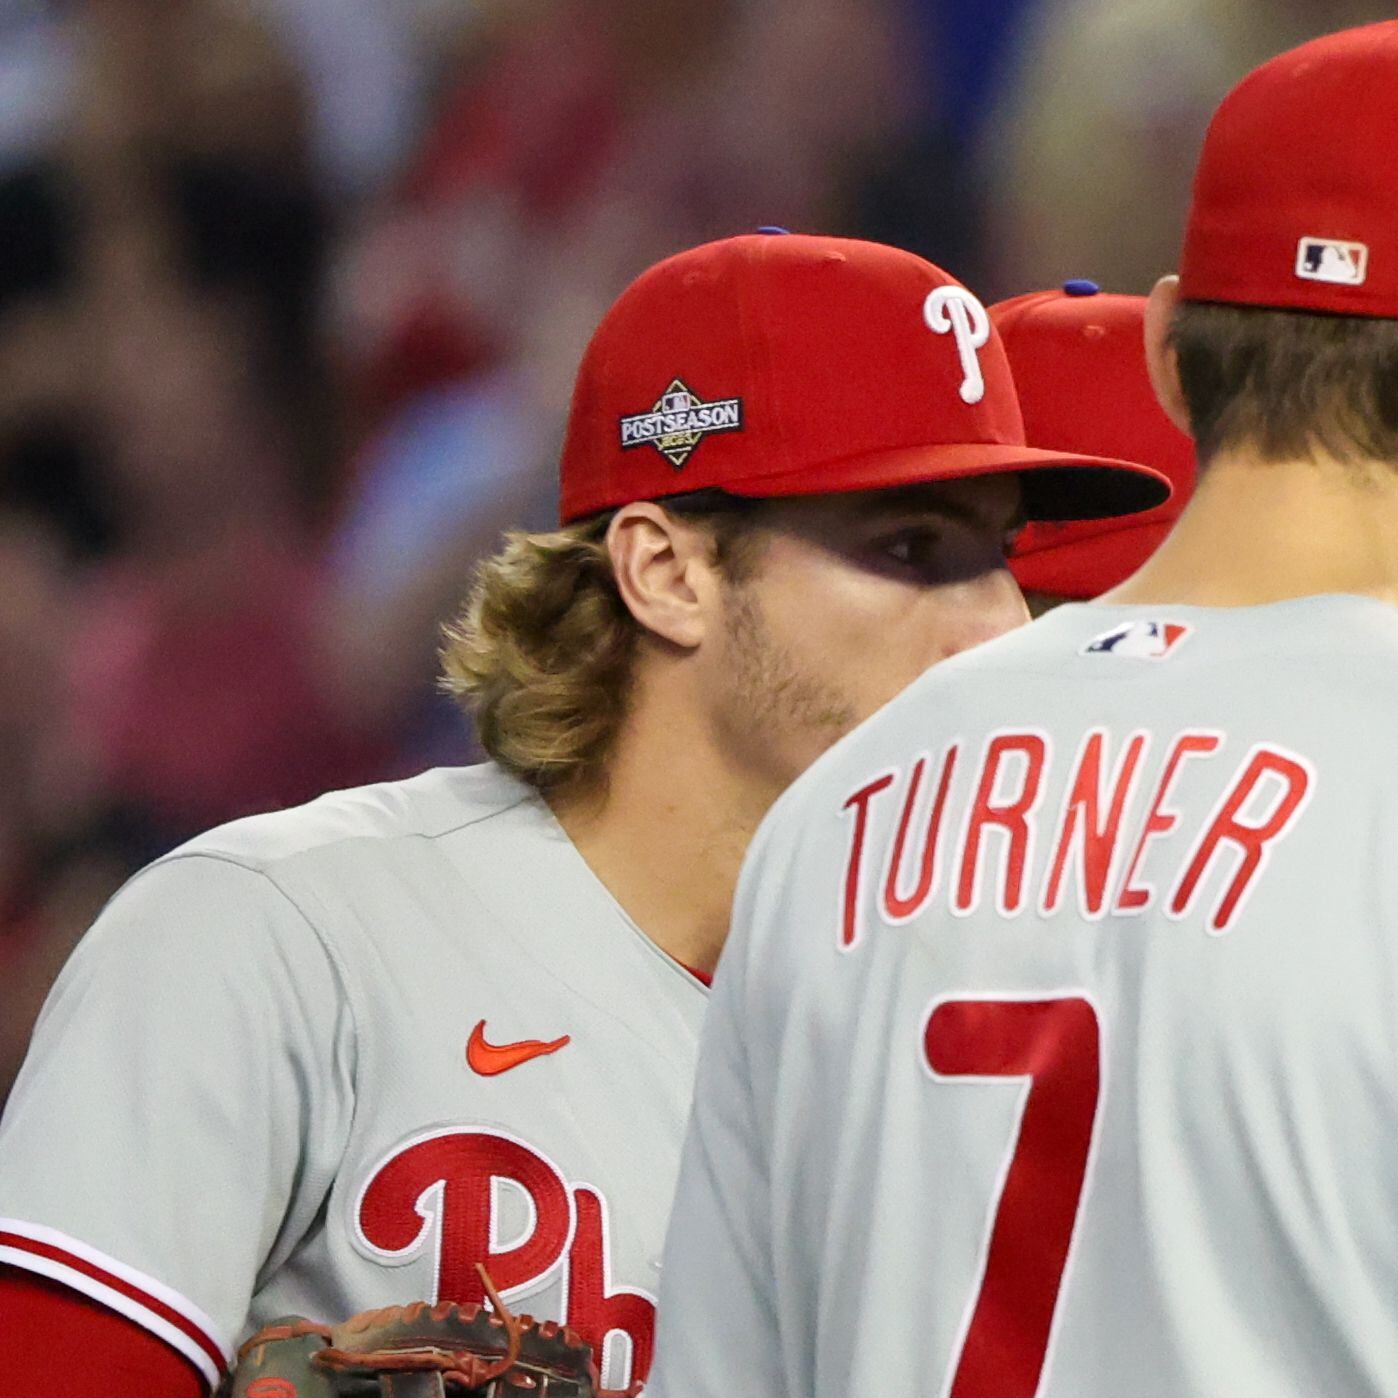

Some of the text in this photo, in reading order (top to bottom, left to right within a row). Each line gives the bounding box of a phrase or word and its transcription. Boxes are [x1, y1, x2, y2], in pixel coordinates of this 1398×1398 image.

[924, 284, 990, 404] P
[620, 403, 739, 442] POSTSEASON
[836, 725, 1317, 952] TURNER
